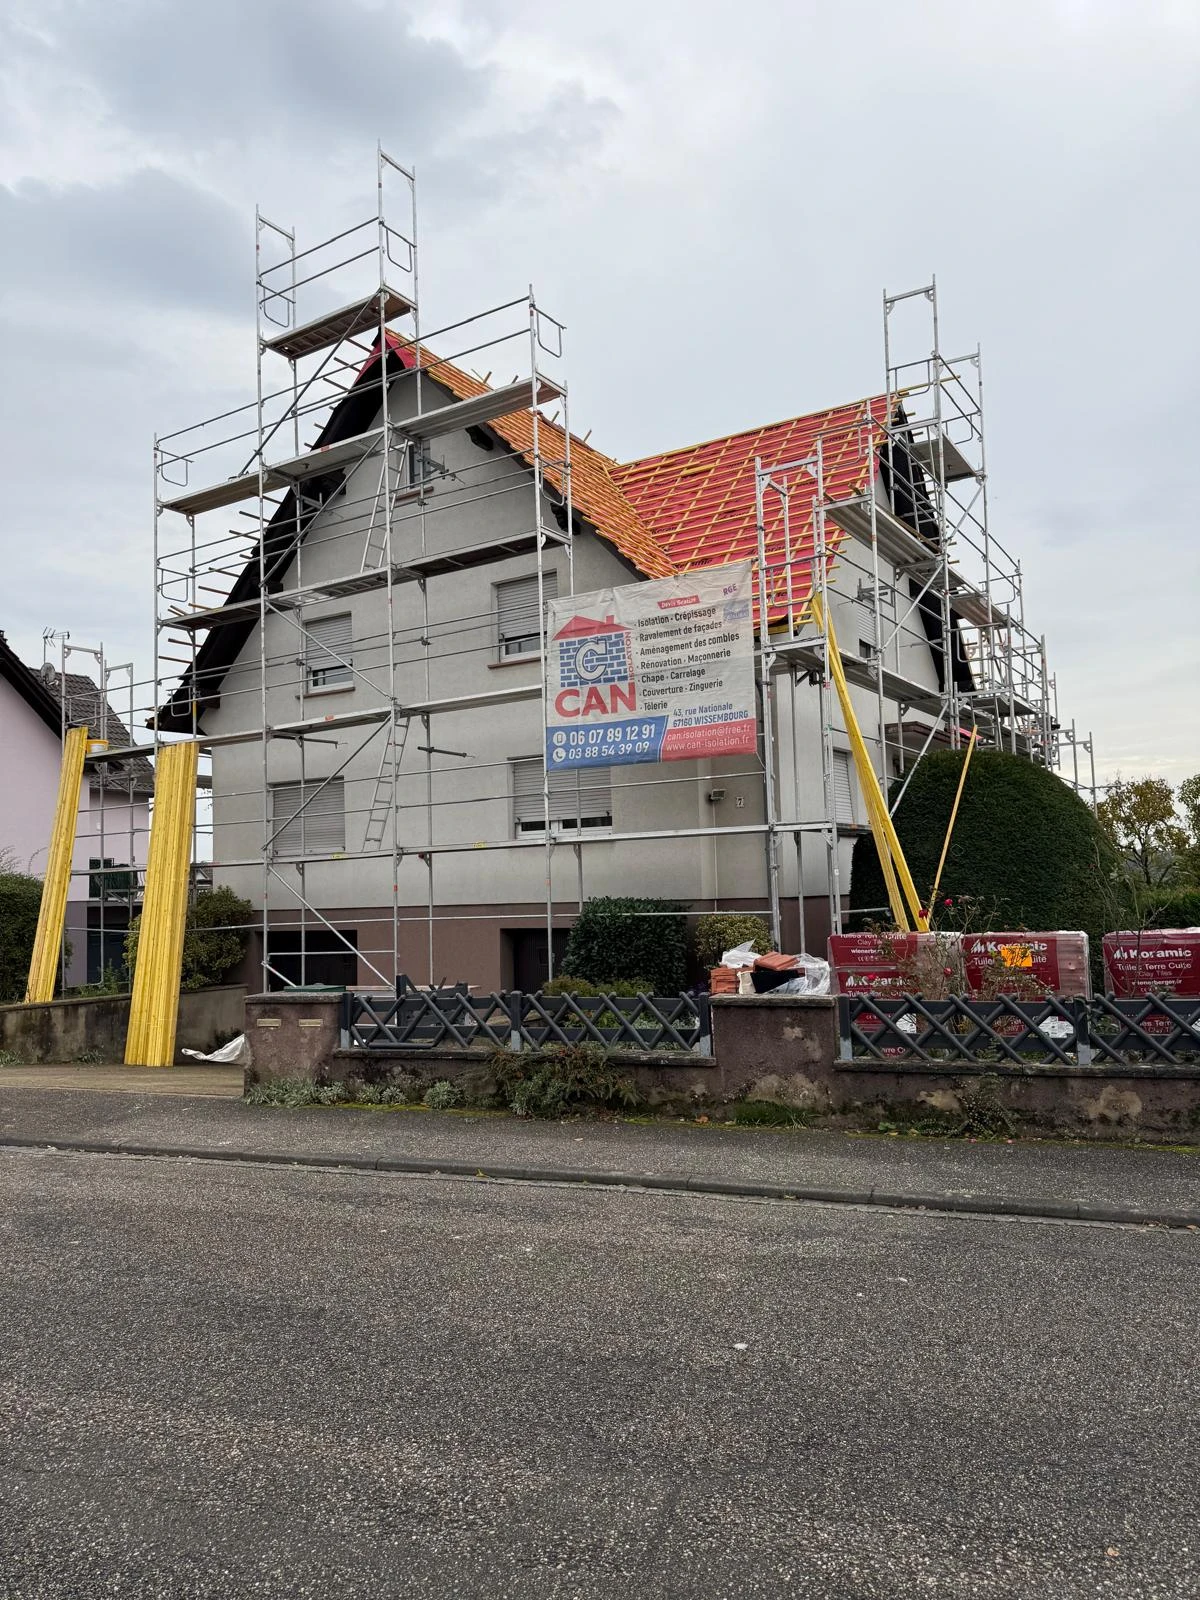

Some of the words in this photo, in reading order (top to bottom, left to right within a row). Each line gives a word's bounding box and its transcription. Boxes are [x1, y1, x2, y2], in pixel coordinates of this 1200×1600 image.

[723, 584, 737, 595] RGE
[638, 616, 669, 627] Isolation
[675, 607, 716, 621] Crépissage
[640, 629, 682, 642] Ravalement
[683, 626, 692, 634] de
[694, 620, 722, 633] façades
[640, 641, 692, 656] Aménagement
[694, 638, 706, 648] des
[708, 632, 740, 645] combles
[640, 657, 682, 670] Rénovation
[687, 649, 731, 663] Maçonnerie
[641, 674, 664, 683] Chape
[670, 668, 706, 680] Carrelage
[642, 686, 684, 697] Couverture
[689, 679, 723, 692] Zinguerie
[555, 682, 637, 718] CAN
[644, 700, 668, 711] Tôlerie
[698, 702, 733, 714] Nationale
[673, 718, 692, 728] 67160
[694, 710, 748, 725] WISSEMBOURG
[570, 731, 585, 746] 06
[588, 729, 604, 744] 07
[606, 727, 622, 743] 89
[625, 725, 639, 741] 12
[642, 723, 655, 739] 91
[666, 734, 750, 752] www.can-isolation.fr
[568, 748, 582, 760] 03
[584, 746, 599, 758] 88
[601, 744, 615, 756] 54
[618, 743, 633, 755] 39
[635, 741, 650, 753] 09
[1129, 948, 1192, 958] Koramic
